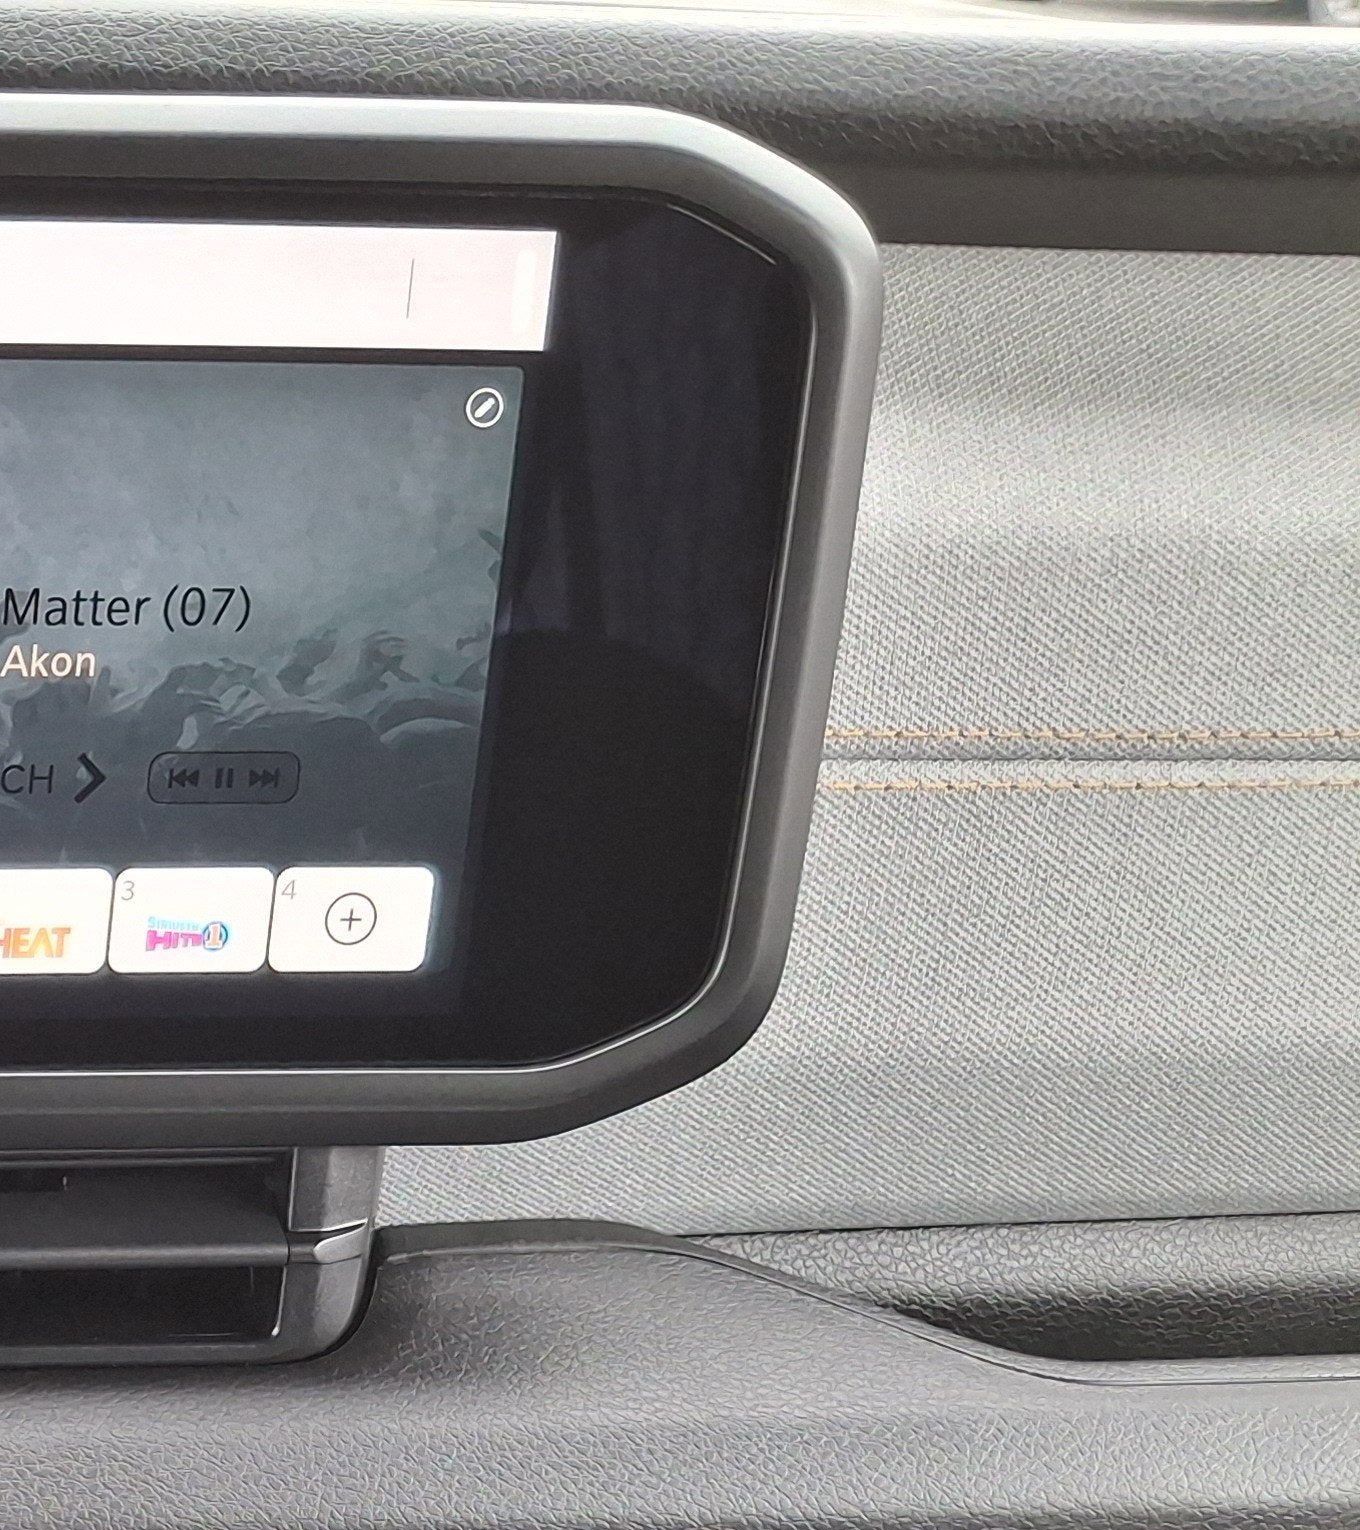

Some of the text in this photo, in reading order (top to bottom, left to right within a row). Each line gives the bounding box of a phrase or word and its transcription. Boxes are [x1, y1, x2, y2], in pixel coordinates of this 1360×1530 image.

[2, 587, 150, 629] Matter
[161, 585, 253, 633] (07)
[0, 644, 97, 680] Akon
[0, 763, 54, 795] CH
[121, 880, 135, 901] 3
[281, 879, 297, 900] 4
